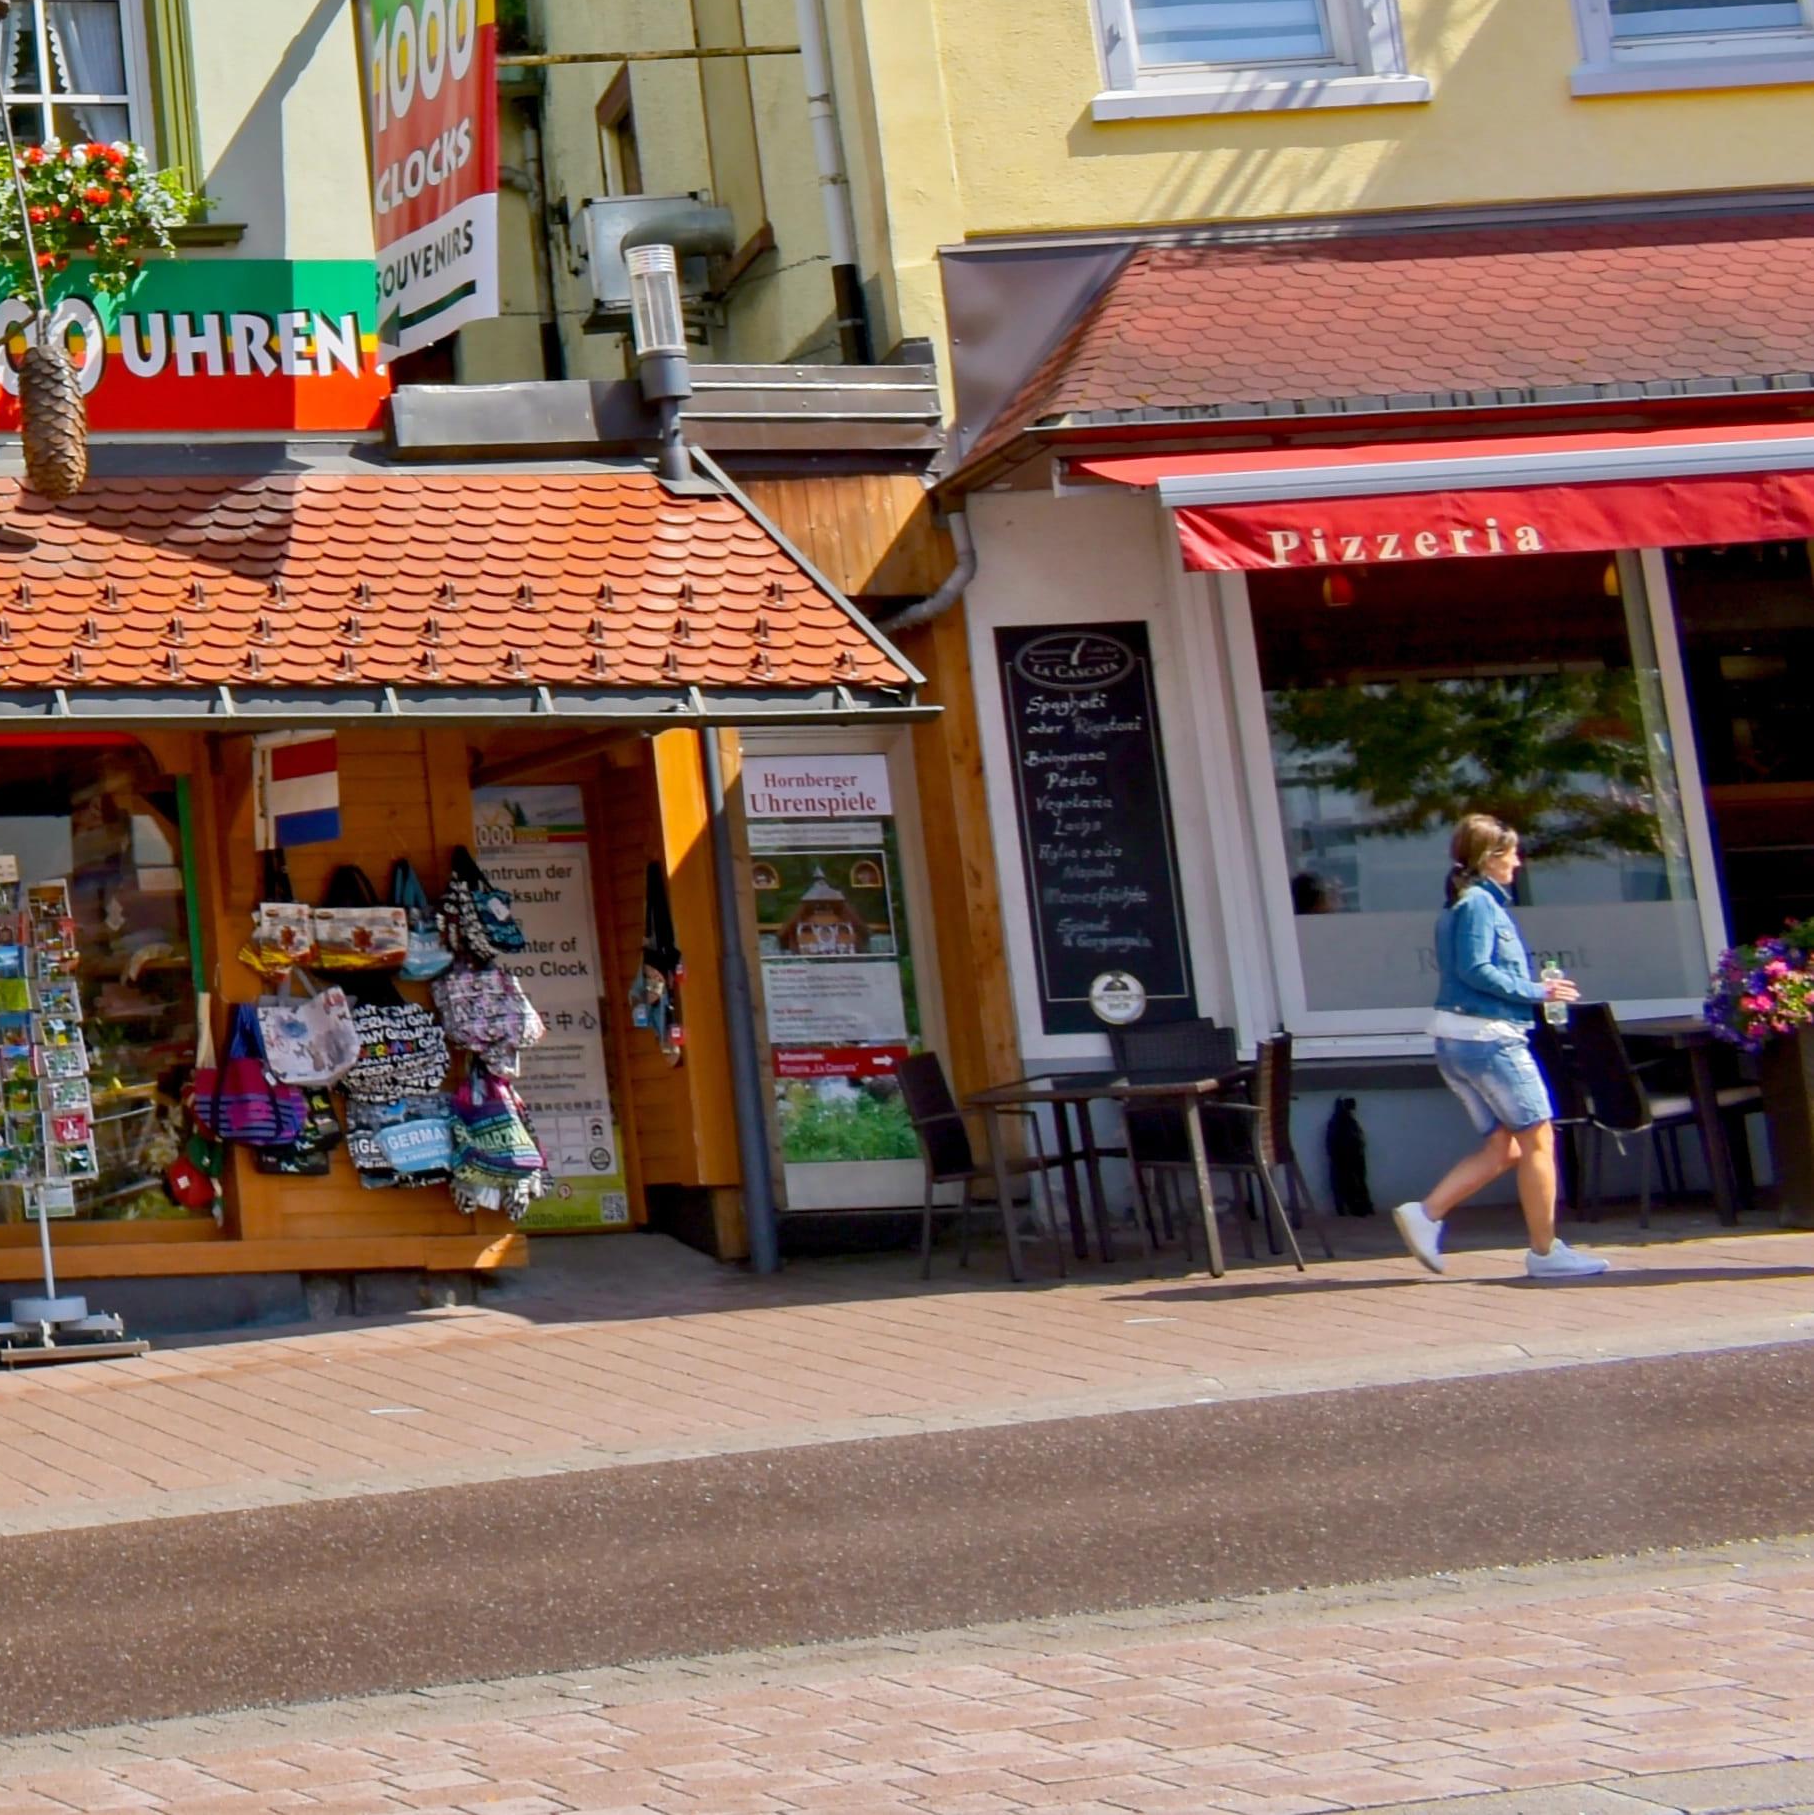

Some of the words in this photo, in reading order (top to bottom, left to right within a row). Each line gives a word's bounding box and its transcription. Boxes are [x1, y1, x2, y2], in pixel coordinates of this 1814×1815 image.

[375, 117, 472, 215] CLOCKS
[375, 220, 474, 303] SOUVENIRS
[119, 312, 360, 379] UHREN
[1266, 517, 1543, 568] Pizzeria
[1027, 722, 1064, 735] oder
[763, 772, 858, 790] Hornberger
[1045, 770, 1098, 789] Pesto
[750, 791, 876, 817] Uhrenspiele
[477, 825, 514, 846] 000
[545, 865, 574, 880] der
[560, 937, 577, 953] of
[539, 960, 588, 976] Clock
